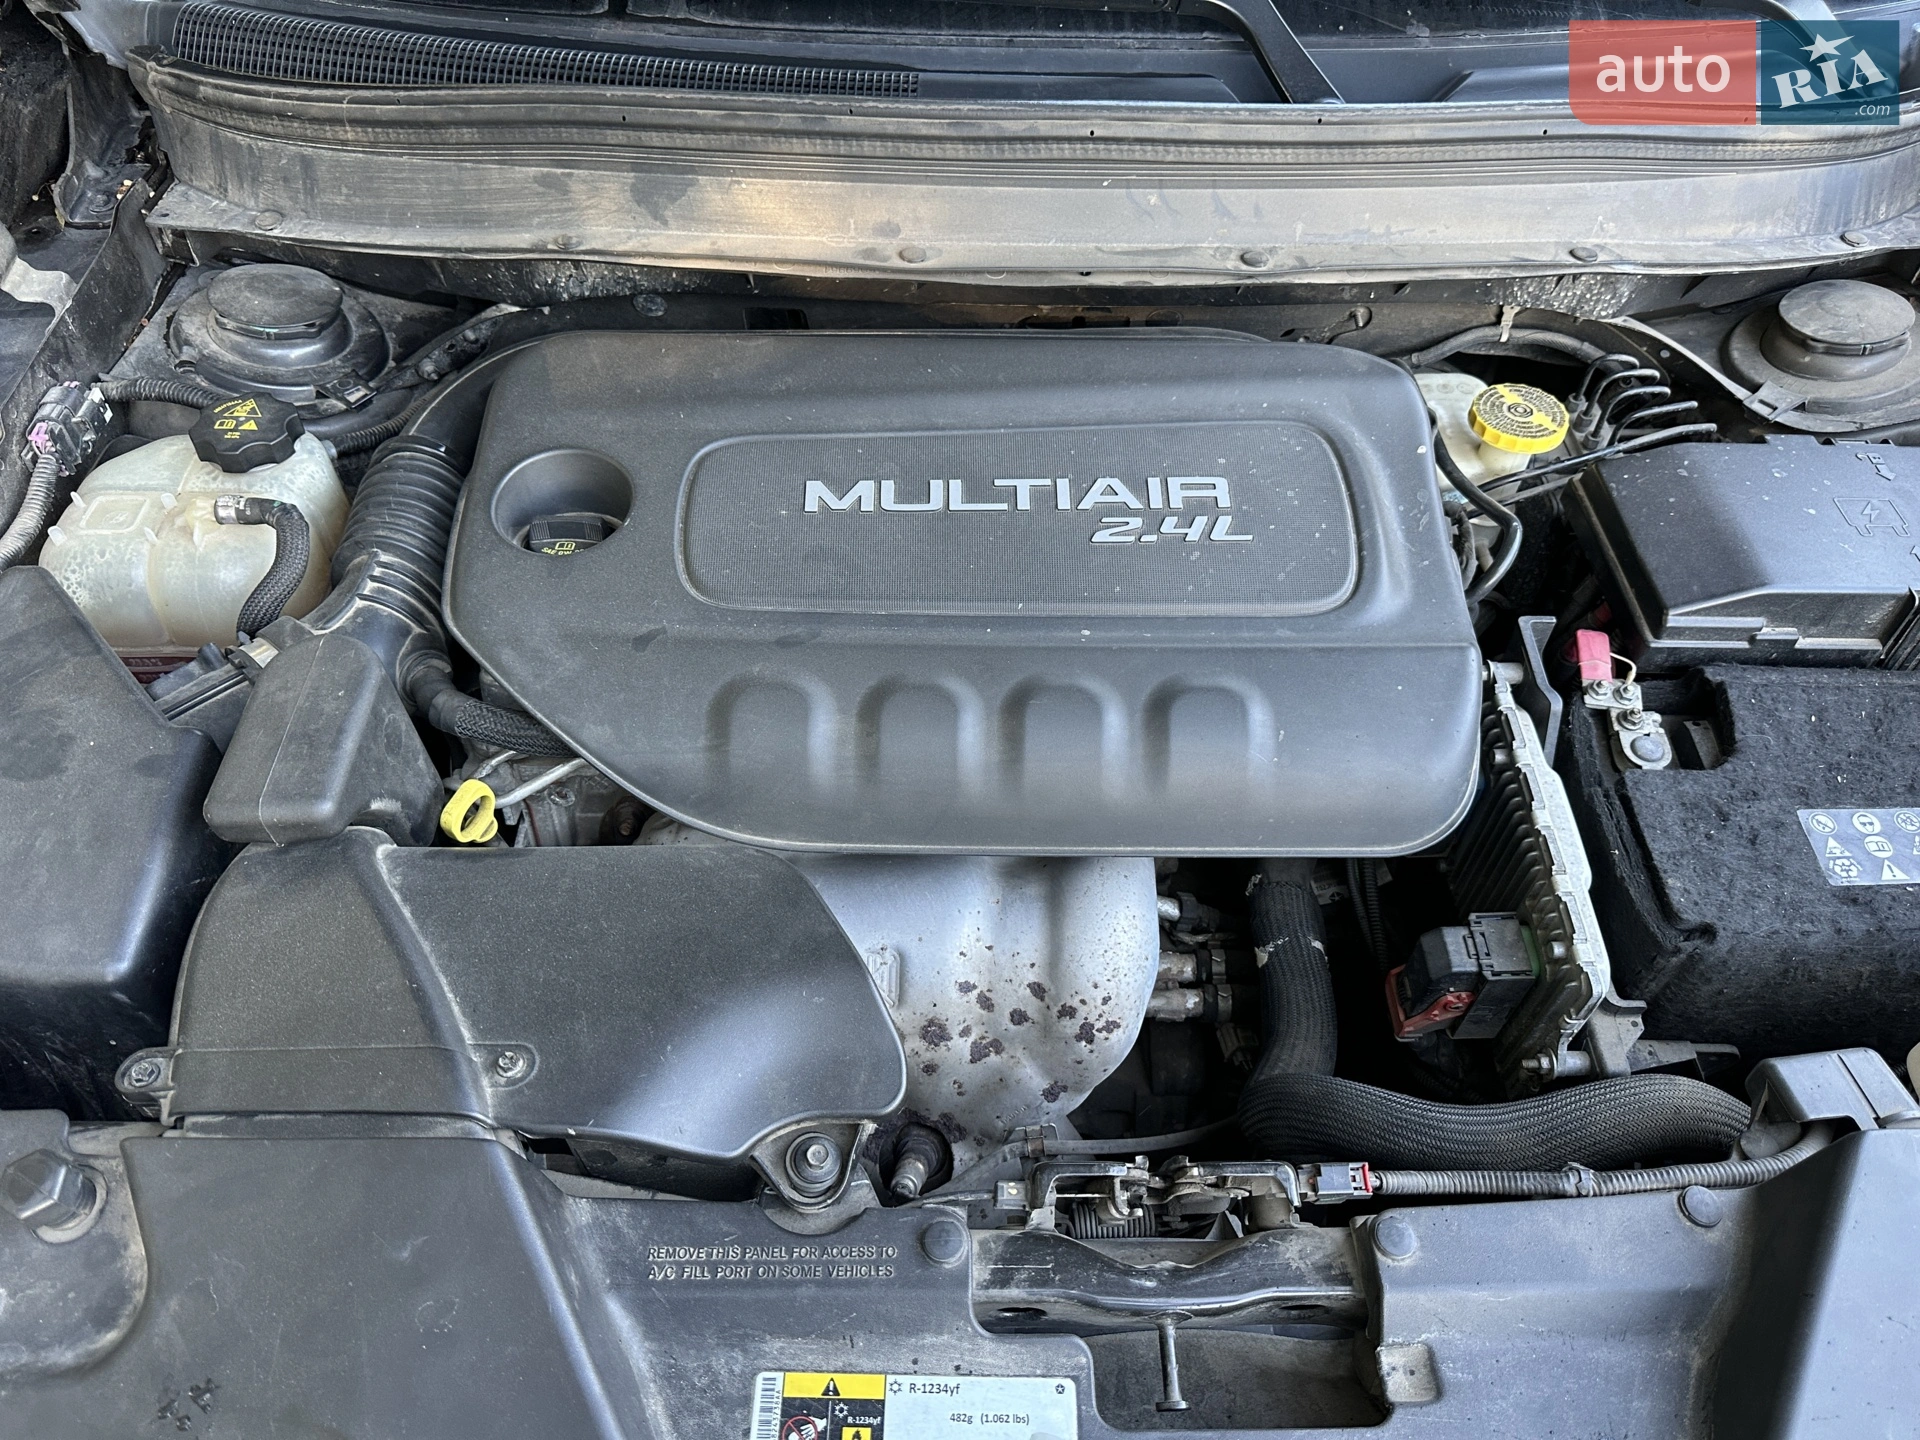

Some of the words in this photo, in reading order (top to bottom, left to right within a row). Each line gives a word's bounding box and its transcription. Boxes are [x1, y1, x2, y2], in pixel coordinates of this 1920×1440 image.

[804, 477, 1231, 514] MULTIAIR
[1090, 516, 1254, 543] 2.4L
[648, 1246, 706, 1260] REMOVE
[708, 1246, 740, 1260] THIS
[744, 1246, 788, 1260] PANEL
[791, 1246, 818, 1259] FOR
[821, 1245, 876, 1259] ACCESS
[879, 1245, 898, 1259] TO
[648, 1264, 676, 1280] A/C
[682, 1264, 710, 1279] FILL
[715, 1264, 753, 1280] PORT
[757, 1264, 779, 1279] ON
[782, 1264, 822, 1279] SOME
[827, 1264, 894, 1279] VEHICLES
[909, 1383, 961, 1397] R-1234yf
[847, 1416, 881, 1426] R-1234yf
[949, 1413, 973, 1425] 482g
[980, 1412, 1010, 1425] (1.062
[1012, 1412, 1030, 1425] lbs)
